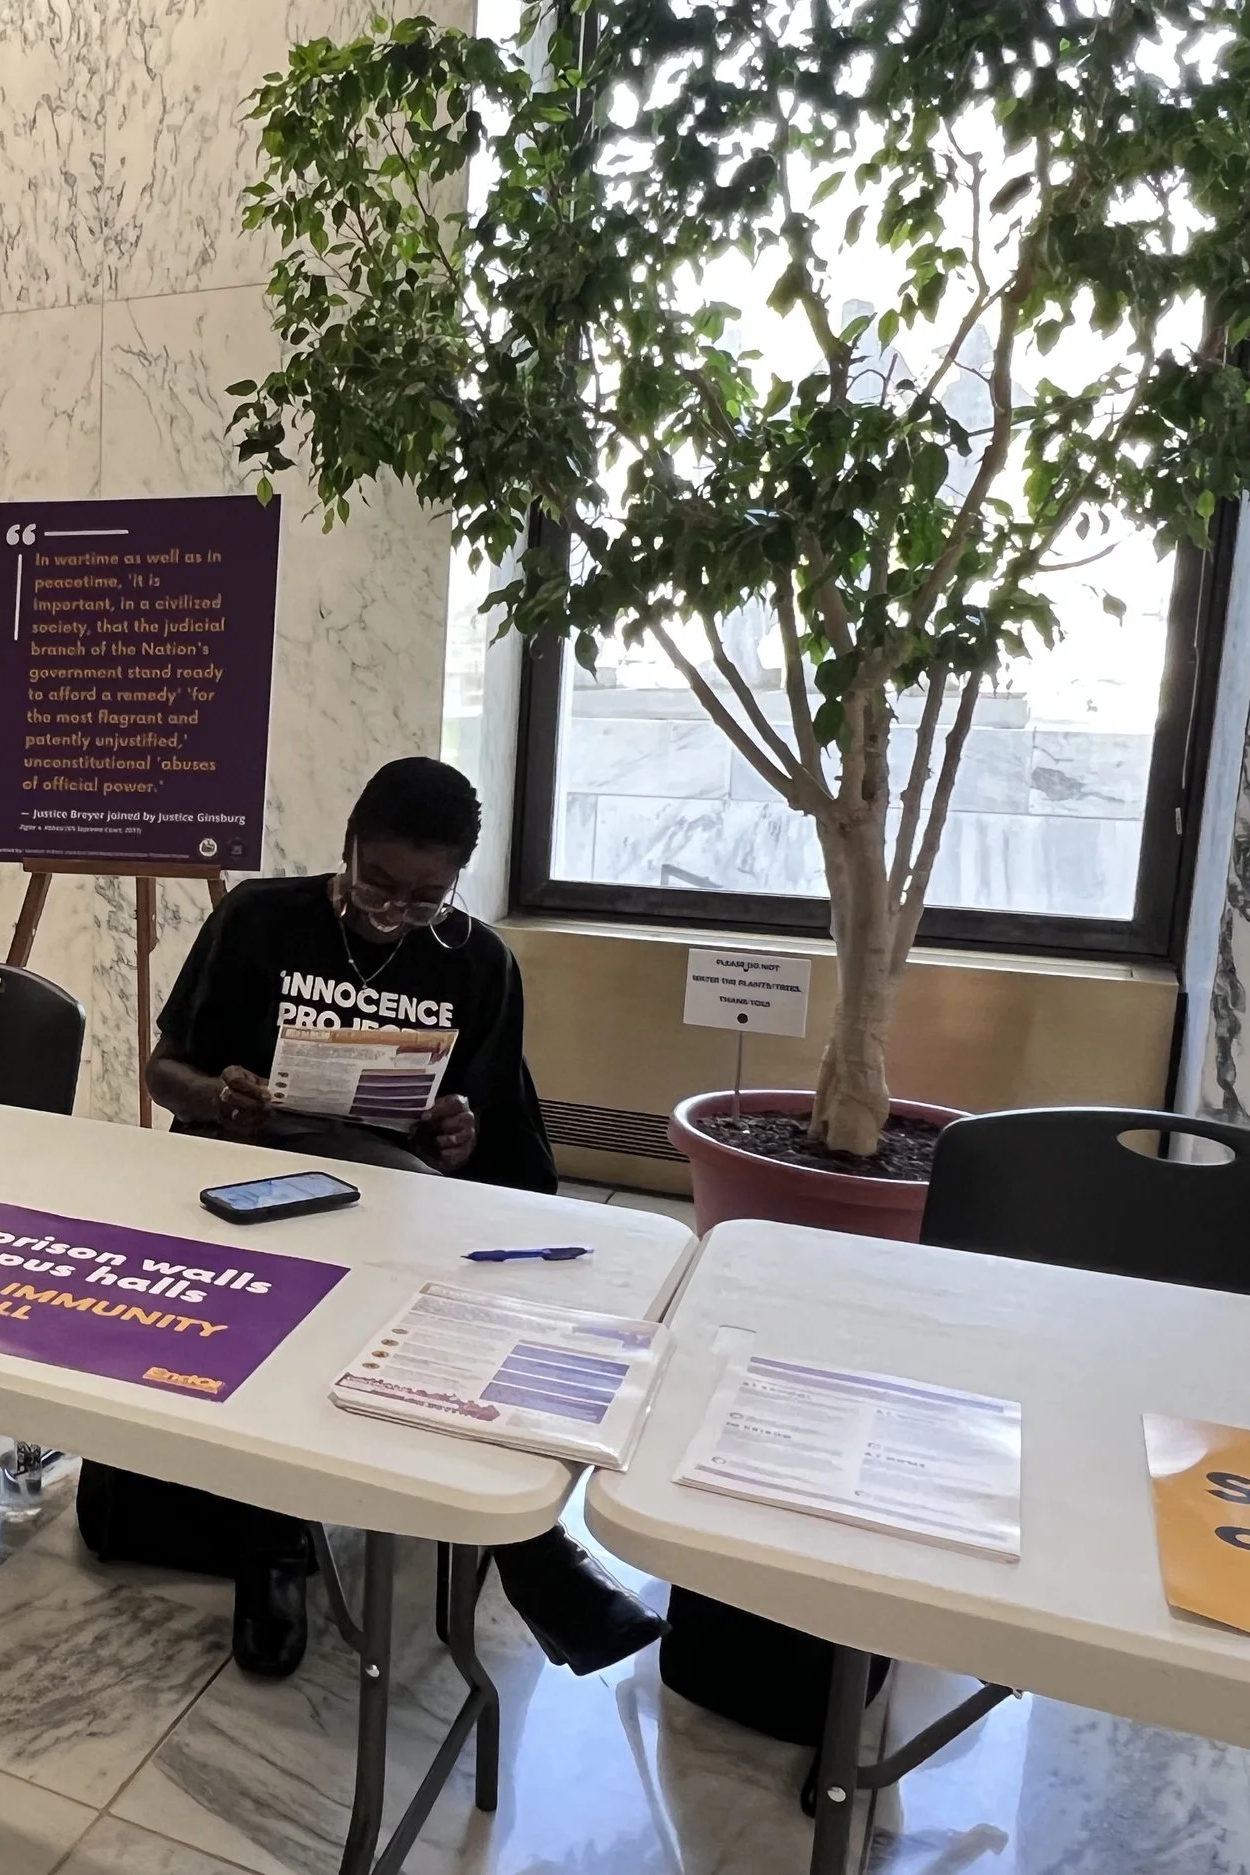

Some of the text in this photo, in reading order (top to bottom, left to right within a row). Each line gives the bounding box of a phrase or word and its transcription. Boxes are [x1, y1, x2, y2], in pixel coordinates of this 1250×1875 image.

[35, 547, 222, 566] In wartime as well as in
[34, 574, 123, 593] peacetime,
[149, 573, 161, 587] is
[33, 593, 222, 615] important, in a civilized
[31, 616, 226, 637] society, that the judicial
[31, 640, 210, 656] branch of the Nation's
[28, 663, 223, 683] government stand ready
[28, 687, 43, 701] to
[48, 686, 96, 701] afford
[101, 691, 112, 701] a
[26, 708, 199, 728] the most flagrant and
[25, 731, 91, 750] patently
[23, 754, 151, 770] unconstitutional
[22, 776, 38, 791] of
[42, 775, 98, 792] official
[32, 809, 68, 820] Justice
[70, 809, 105, 821] Breyer
[106, 810, 141, 822] joined
[143, 811, 156, 823] by
[157, 811, 194, 823] Justice
[197, 812, 246, 825] Ginsburg
[716, 959, 781, 972] PLEASE DO NOT
[692, 974, 720, 984] WATER
[719, 995, 749, 1005] THANK
[277, 1002, 420, 1032] PROJ
[85, 1265, 208, 1303] halls
[142, 1258, 273, 1294] walls
[0, 1281, 229, 1338] IMMUNITY
